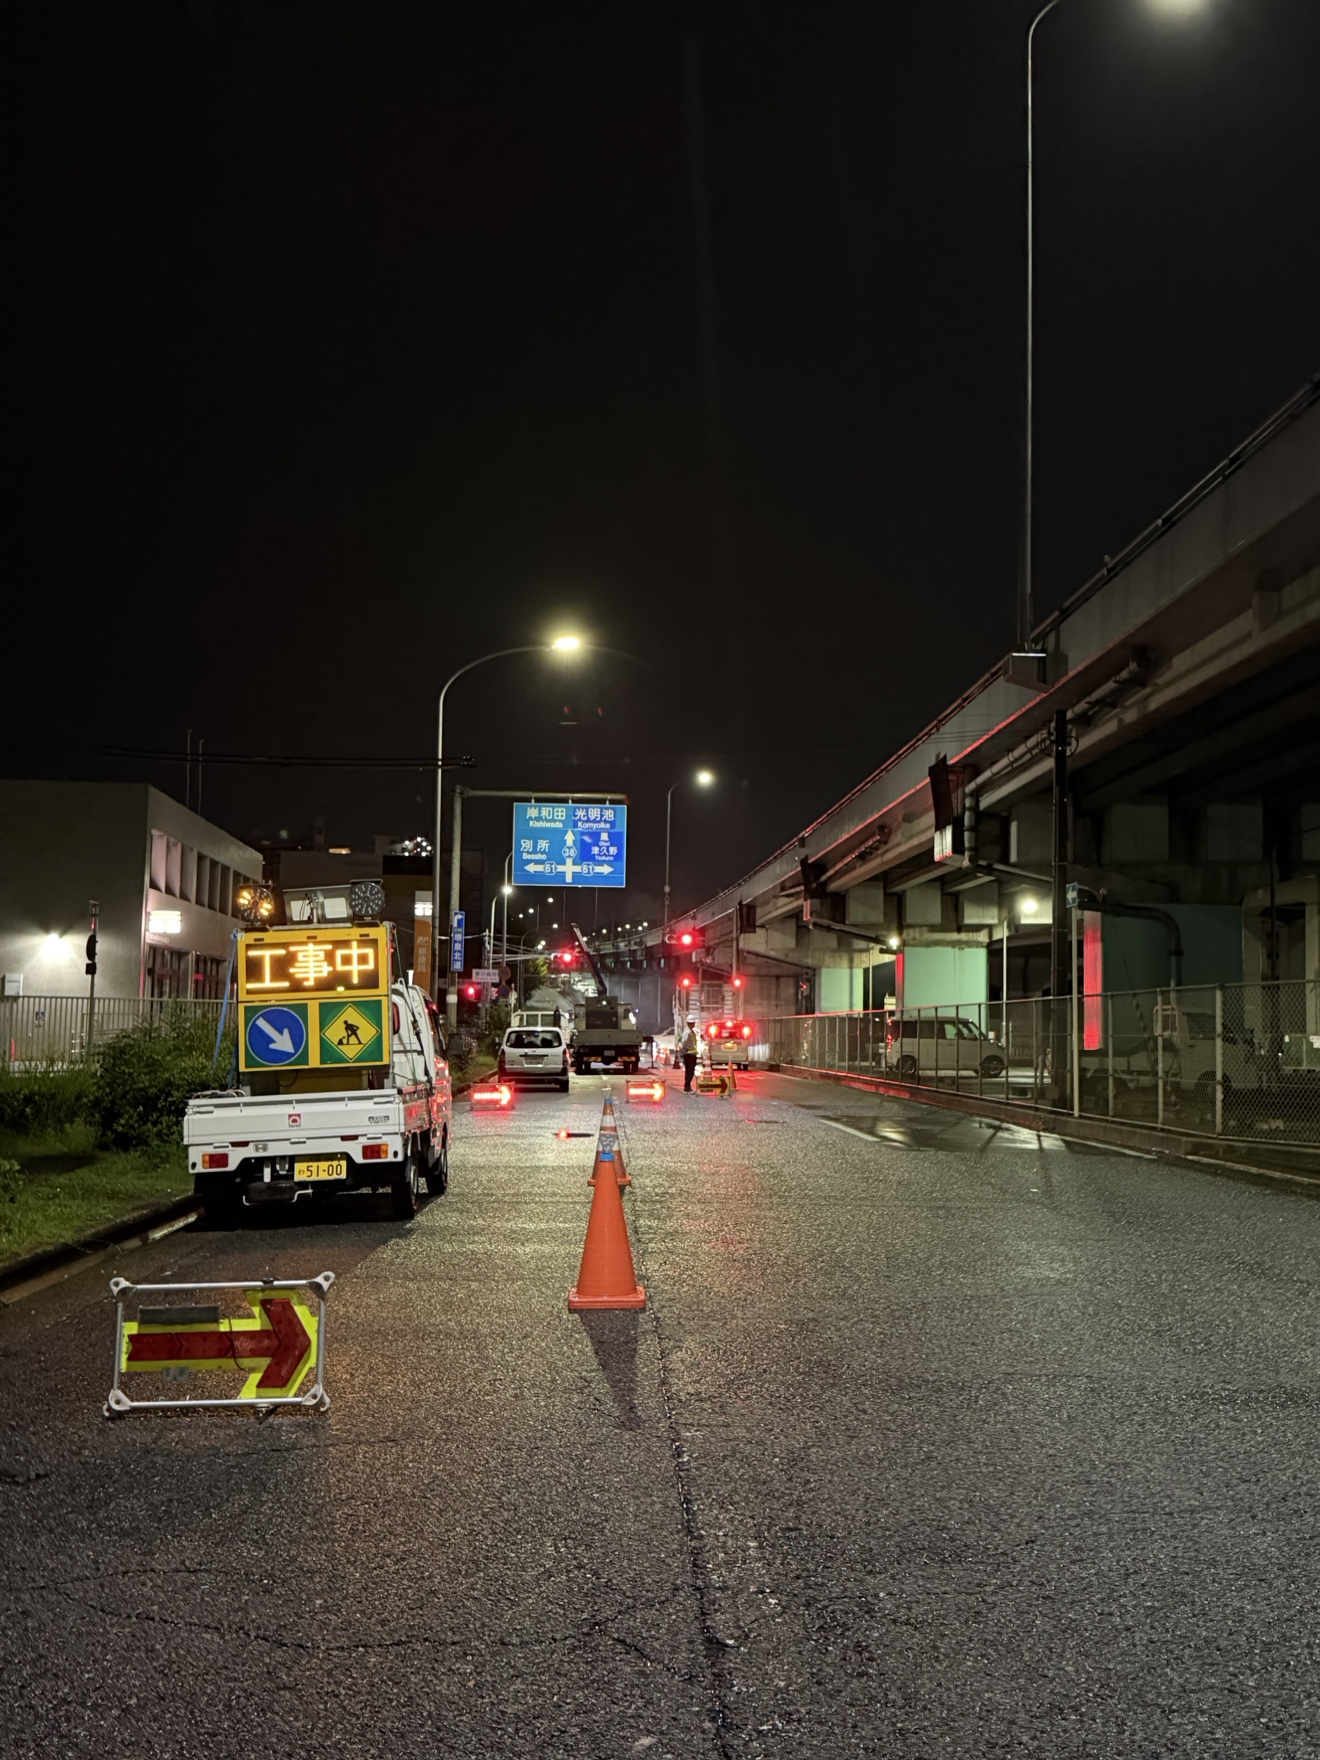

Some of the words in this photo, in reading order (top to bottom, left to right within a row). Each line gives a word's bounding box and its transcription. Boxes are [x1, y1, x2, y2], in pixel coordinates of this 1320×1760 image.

[526, 806, 566, 820] 岸和田
[574, 808, 615, 821] 光明池
[529, 820, 563, 828] Kishiwada
[577, 821, 611, 830] Komyoike
[520, 839, 550, 852] 別所
[564, 848, 575, 857] 38
[591, 846, 618, 856] 津久野
[522, 852, 547, 860] Bessho
[545, 864, 555, 873] 61
[582, 865, 593, 874] 61
[245, 941, 375, 989] 工事中
[306, 1163, 343, 1178] 51-00
